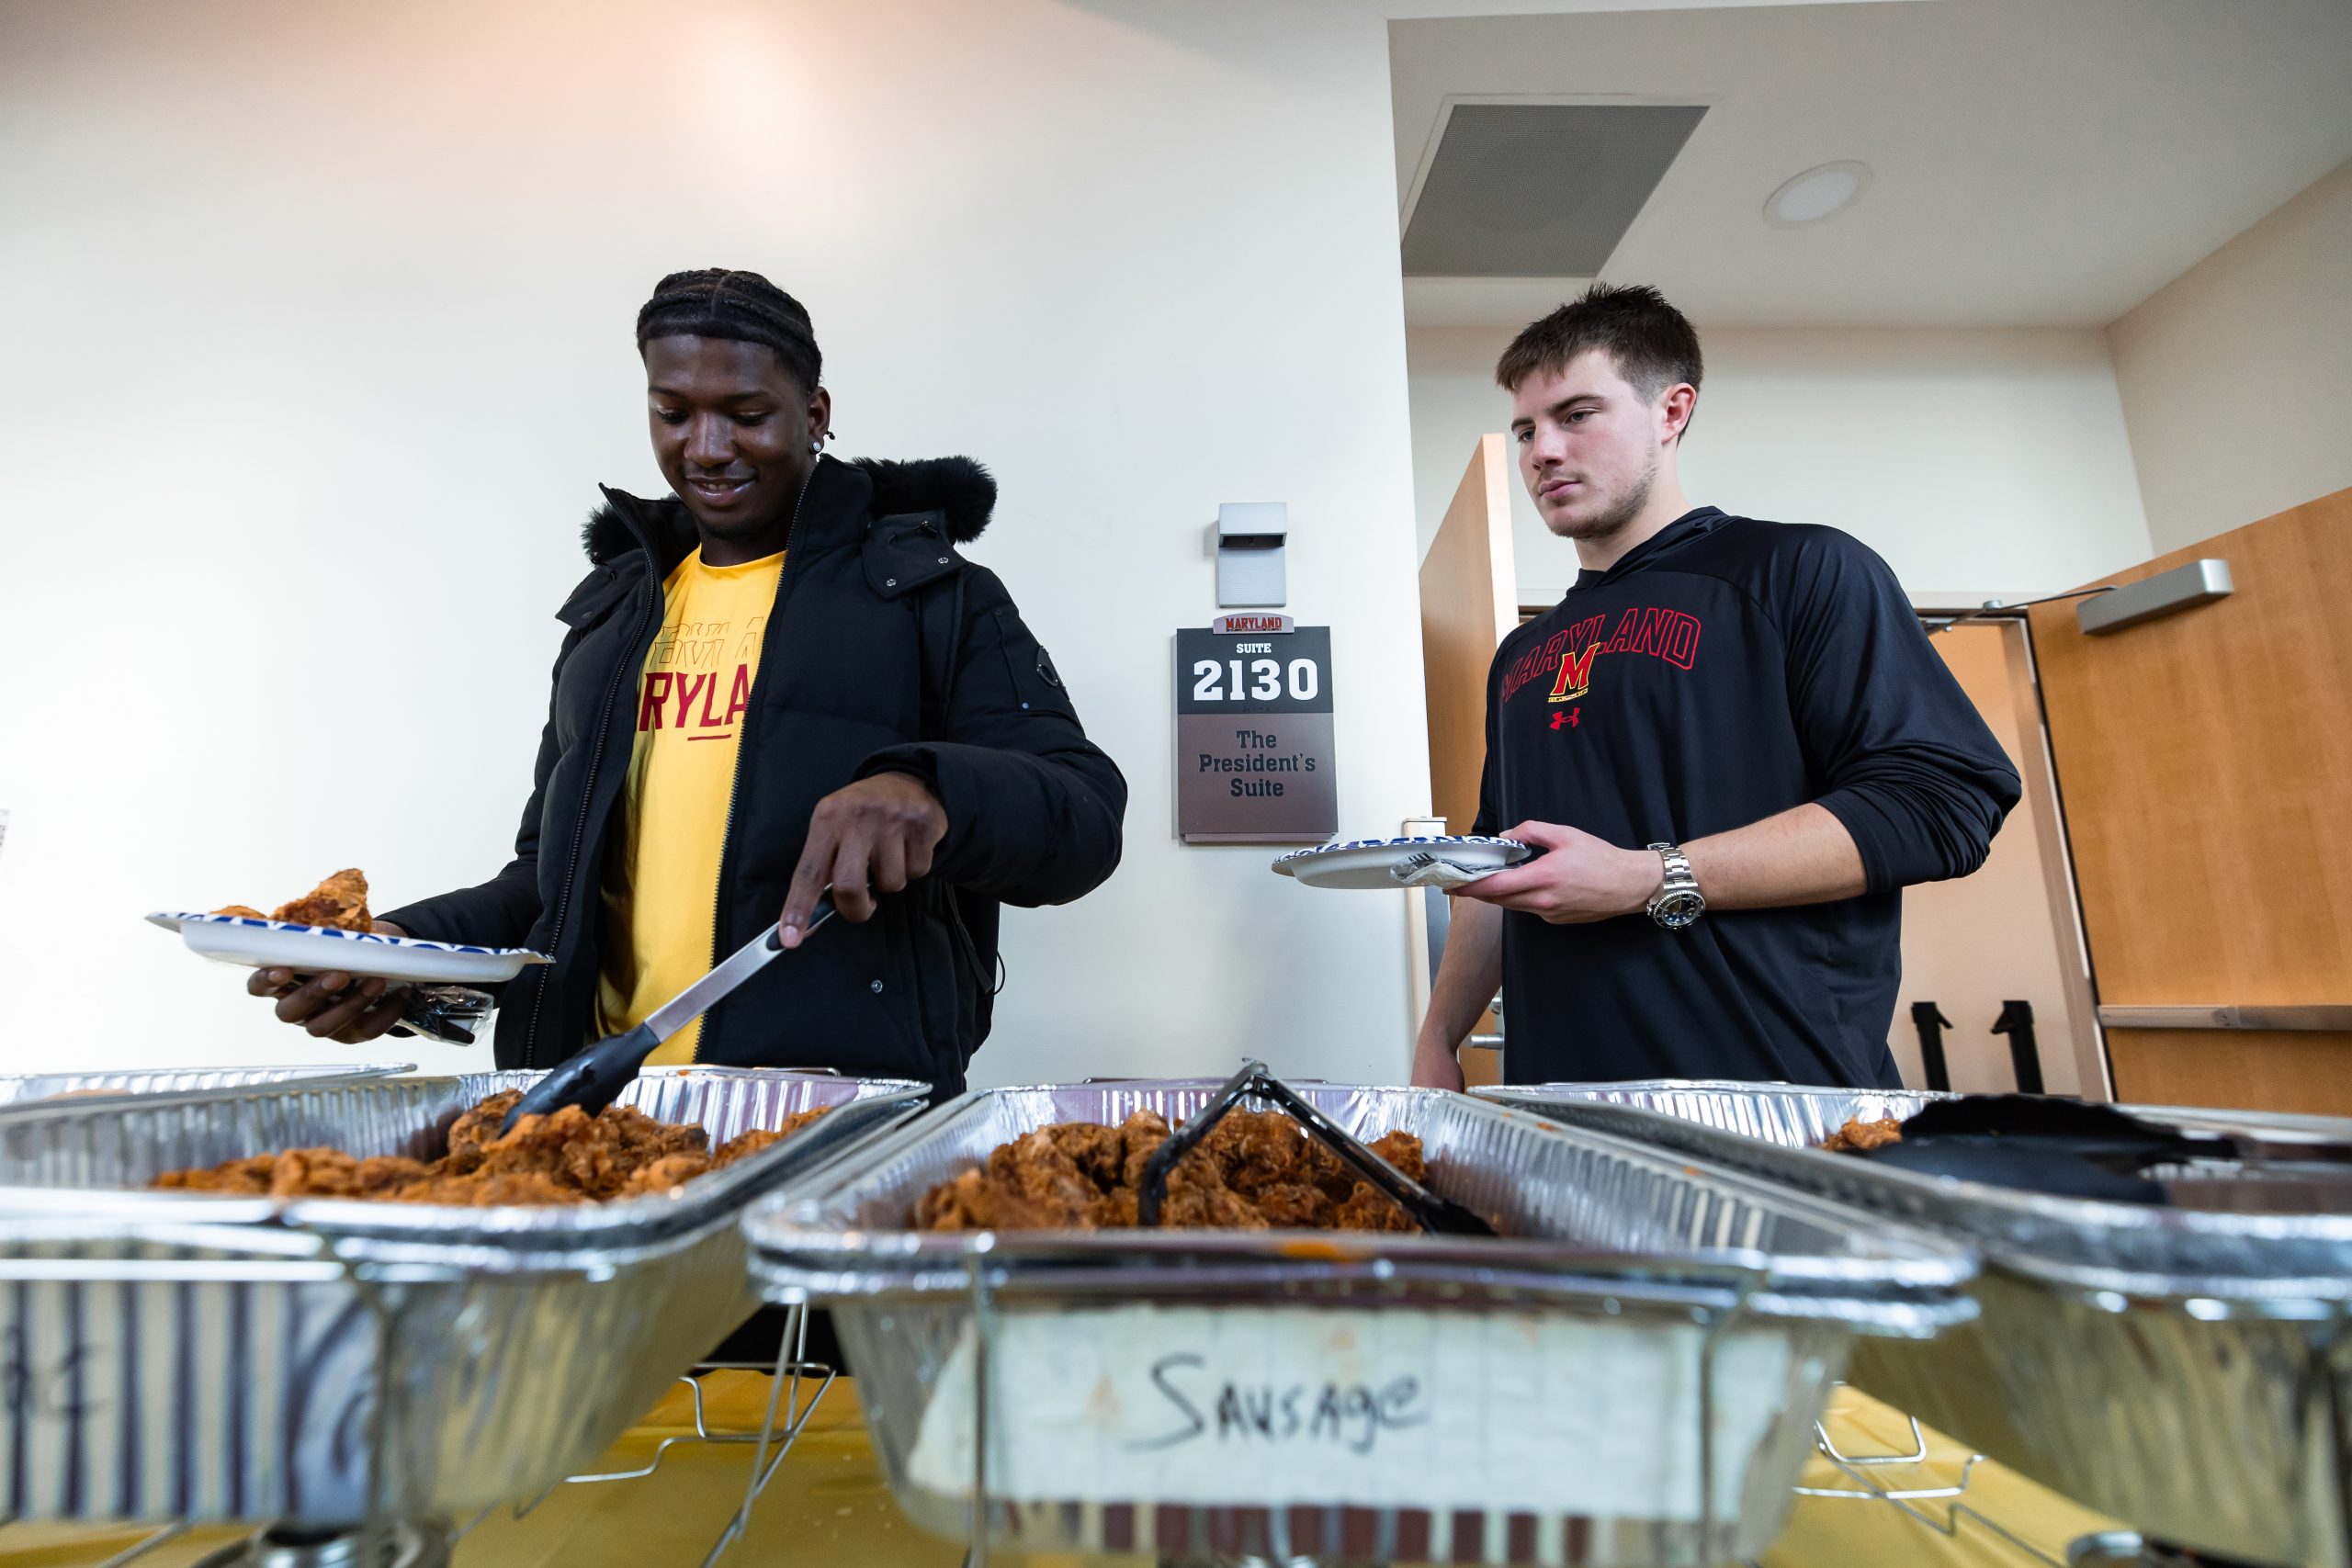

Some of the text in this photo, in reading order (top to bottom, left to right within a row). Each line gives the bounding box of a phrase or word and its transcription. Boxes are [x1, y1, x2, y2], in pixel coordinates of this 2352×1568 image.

[1225, 616, 1283, 629] MARYLAND
[1236, 643, 1272, 654] SUITE
[1501, 607, 1702, 703] MARYLAND
[1193, 658, 1318, 701] 2130
[1236, 730, 1277, 750] The
[1198, 752, 1316, 773] President's
[1230, 777, 1284, 798] Suite
